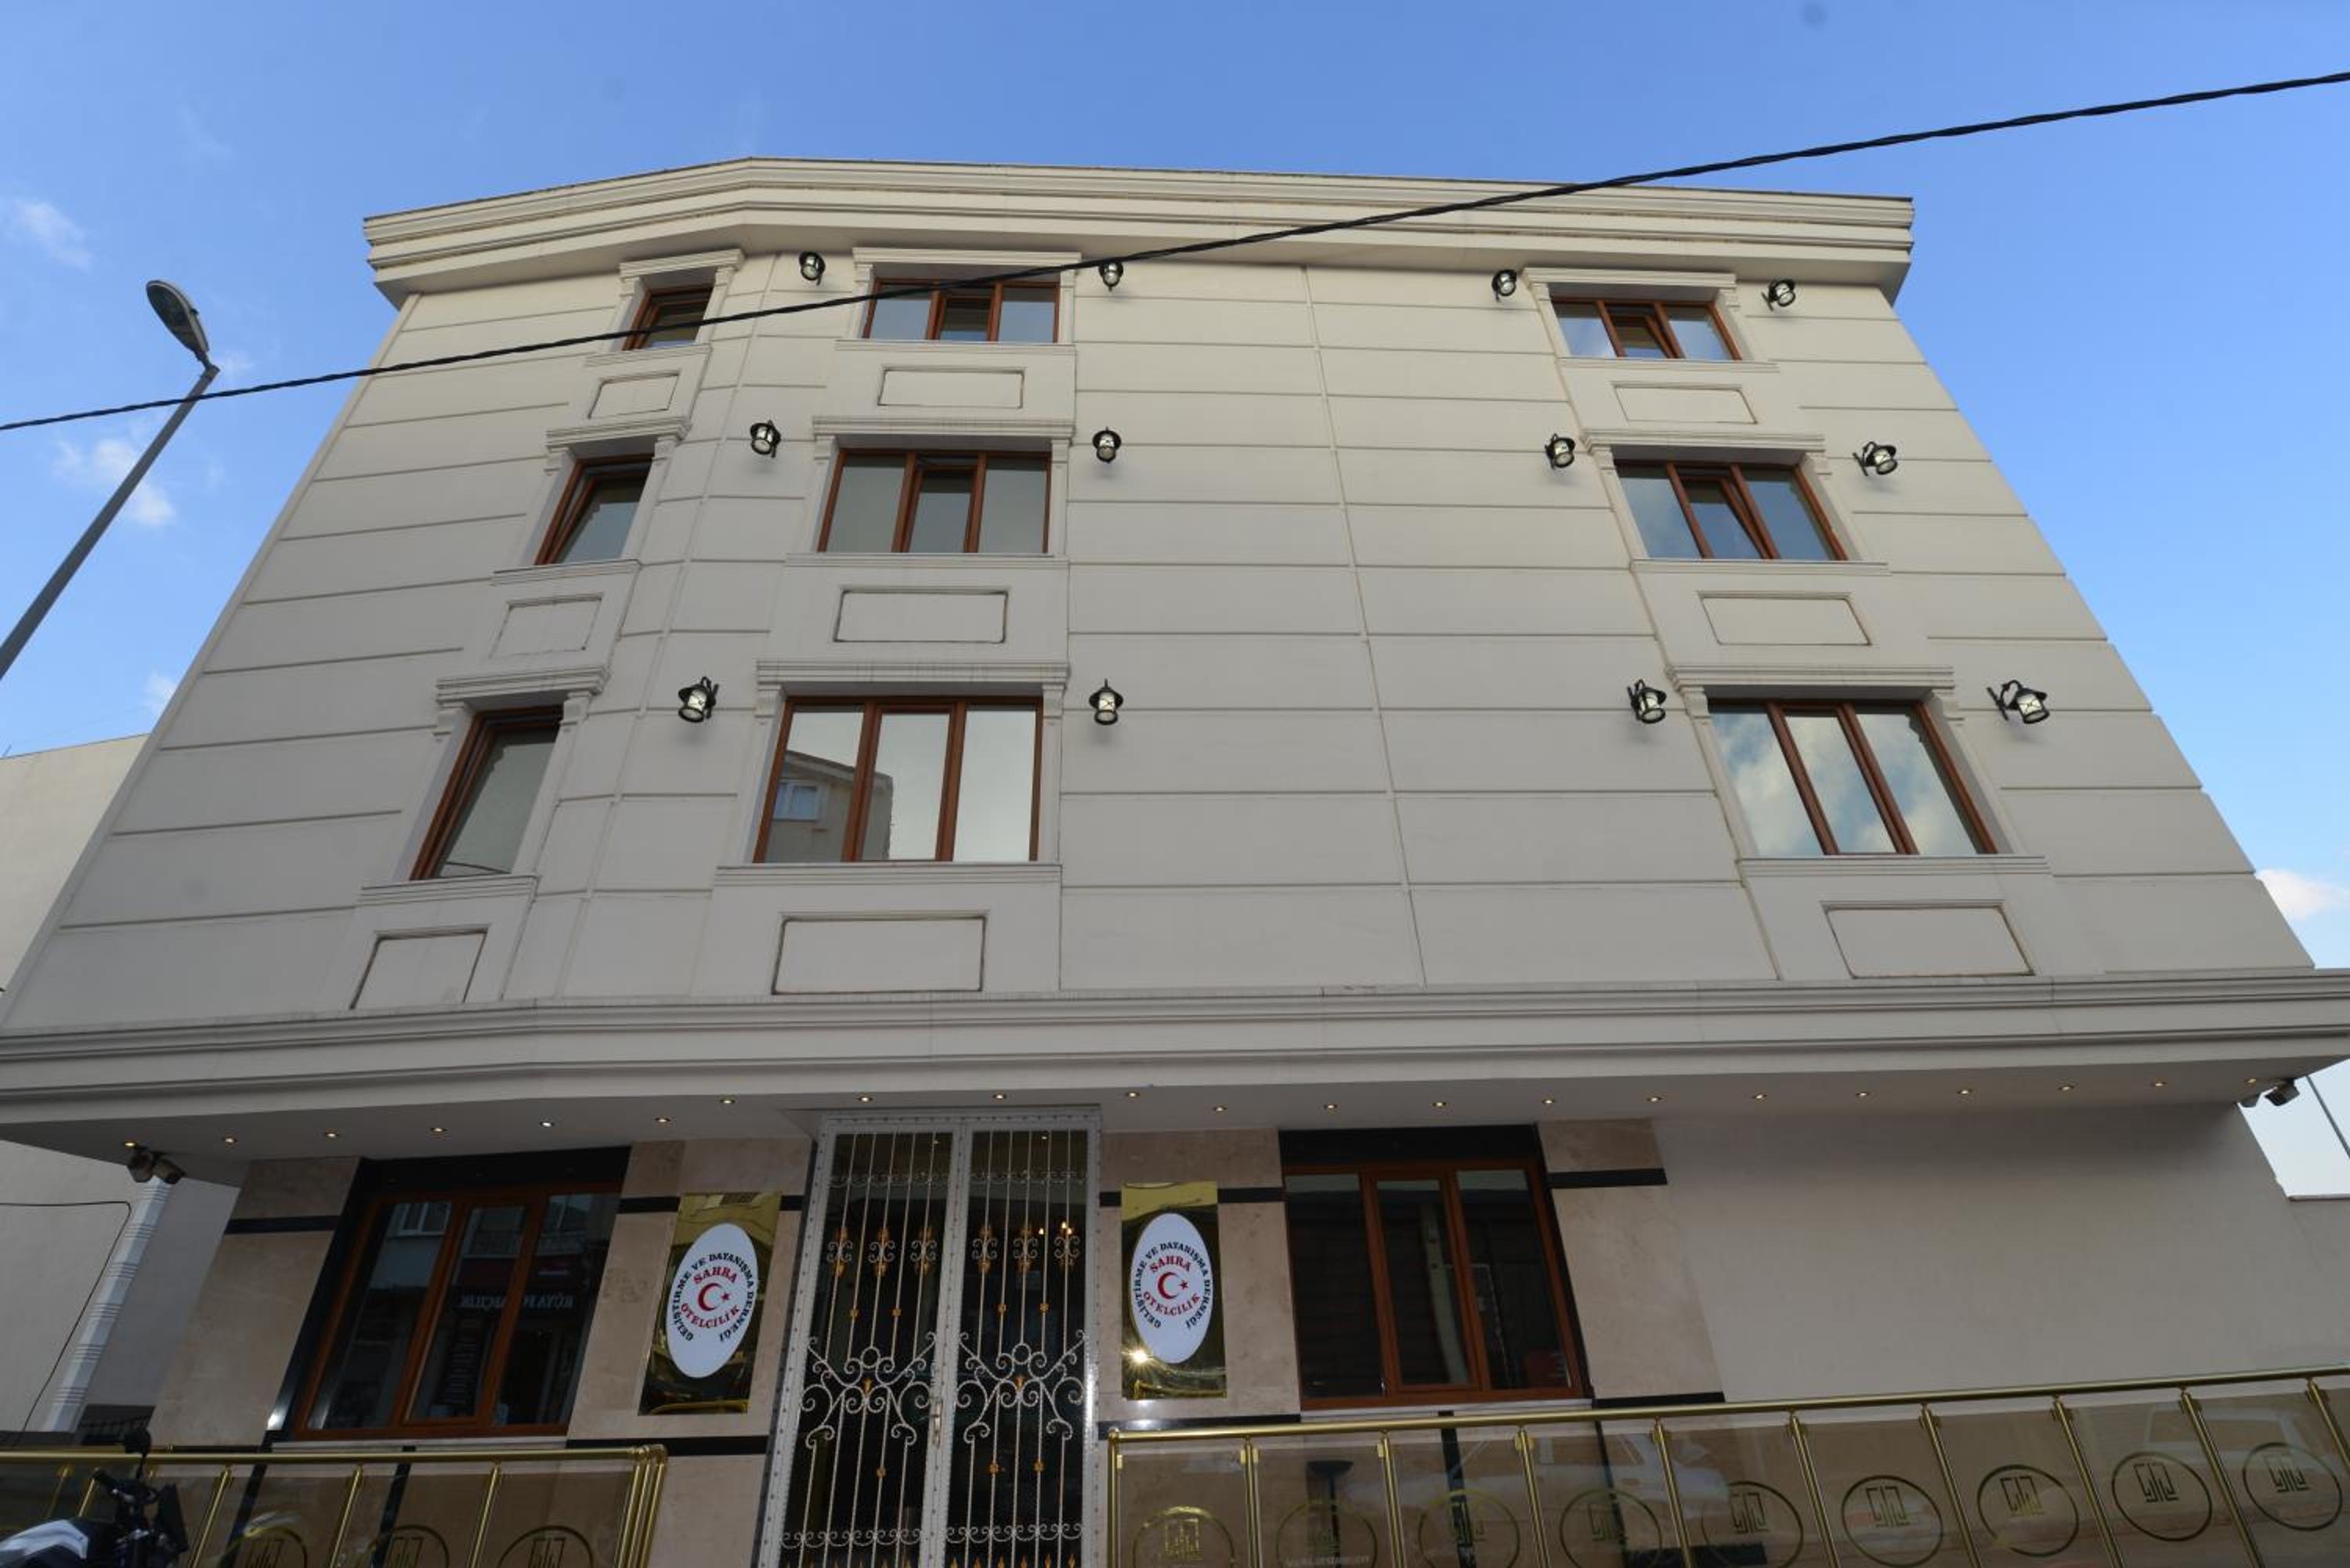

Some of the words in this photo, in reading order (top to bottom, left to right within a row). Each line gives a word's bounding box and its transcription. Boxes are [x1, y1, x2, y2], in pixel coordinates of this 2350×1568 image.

[1145, 1246, 1159, 1259] VE
[692, 1256, 707, 1270] VE
[1149, 1255, 1191, 1274] SAHRA
[692, 1266, 738, 1284] SAHRA
